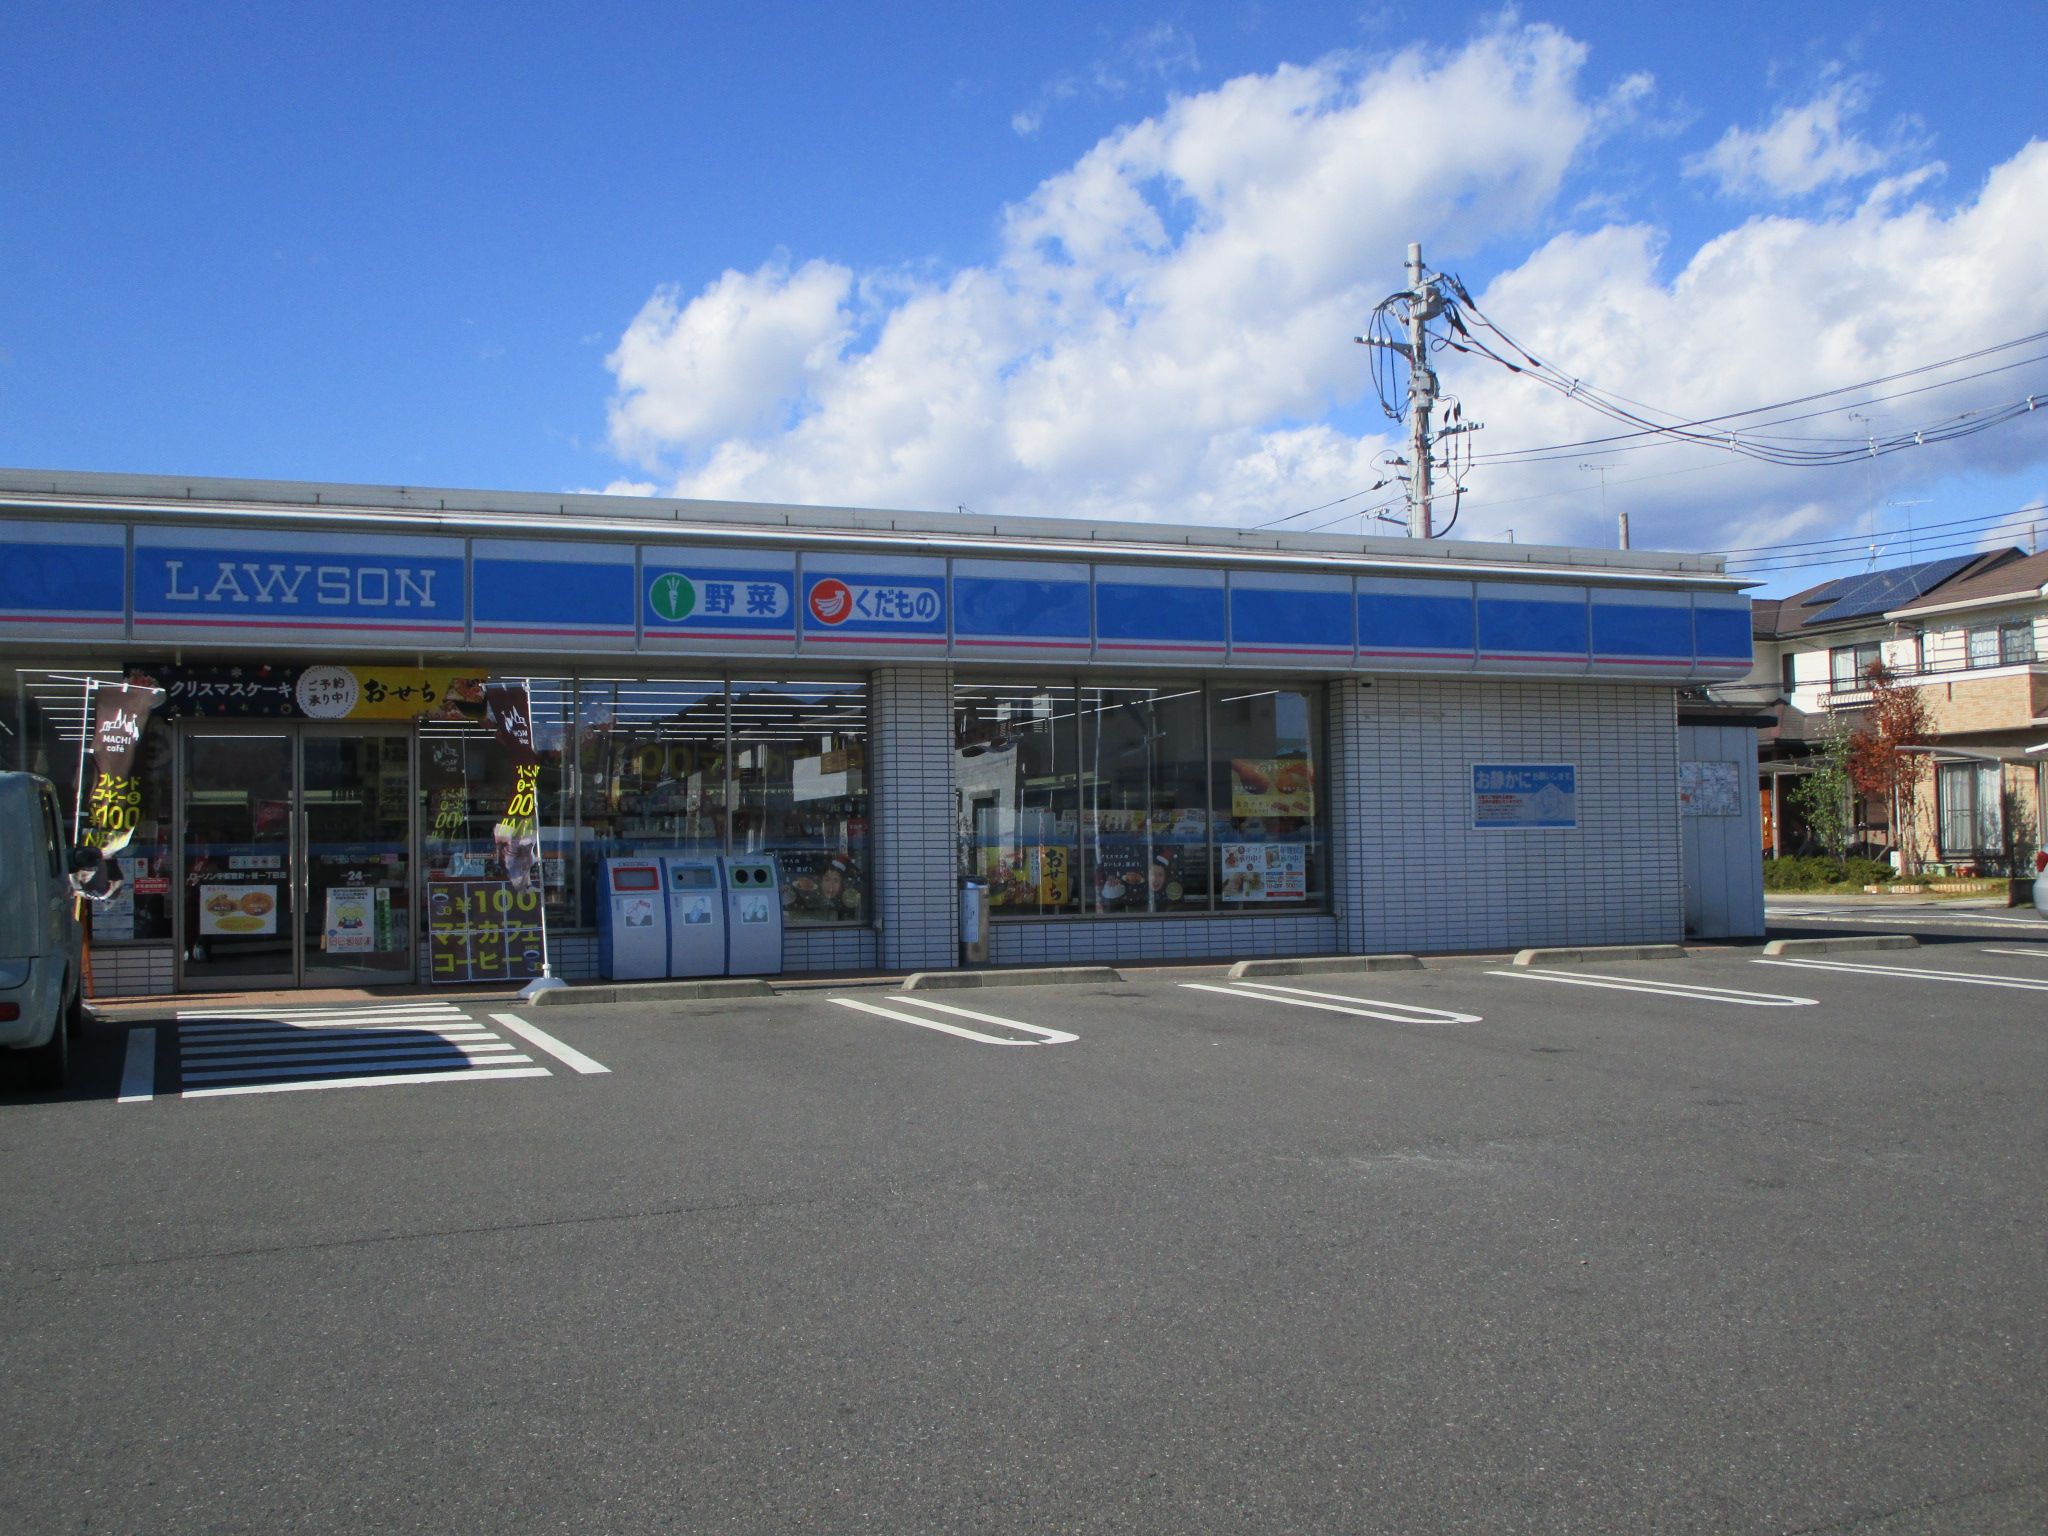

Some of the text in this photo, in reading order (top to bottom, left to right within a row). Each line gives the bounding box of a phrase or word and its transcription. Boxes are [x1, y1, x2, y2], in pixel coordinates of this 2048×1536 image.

[165, 560, 436, 608] LAWSON
[704, 582, 777, 616] 野菜
[854, 588, 937, 620] くだもの
[169, 680, 293, 699] クリスマスケーキ
[307, 677, 346, 692] ご予約
[363, 678, 436, 704] おせち
[102, 734, 132, 746] MACHI
[106, 744, 125, 754] café
[1475, 769, 1532, 790] お静かに
[90, 804, 140, 831] ¥100
[347, 870, 363, 881] 24
[1043, 848, 1065, 901] おせち
[455, 889, 538, 914] ¥100
[431, 920, 541, 946] マチカフェ
[434, 951, 523, 973] コーヒー
